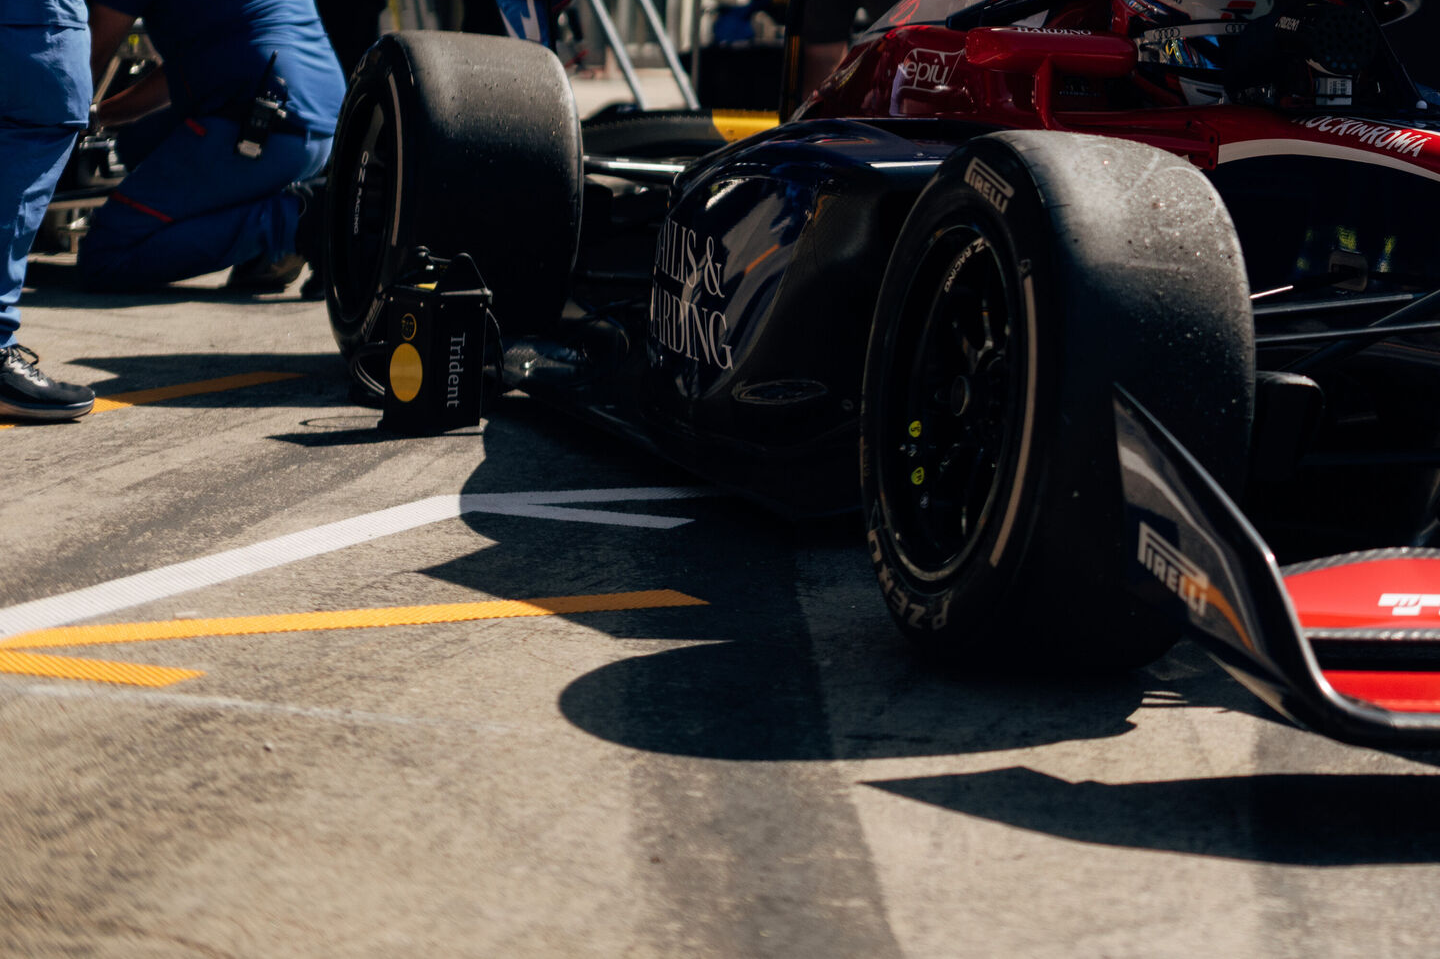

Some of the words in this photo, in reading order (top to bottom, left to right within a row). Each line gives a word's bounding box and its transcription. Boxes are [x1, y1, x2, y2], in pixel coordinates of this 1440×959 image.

[1291, 115, 1432, 158] OCKINROMA
[963, 156, 1015, 214] PIRELLI
[703, 235, 726, 298] &
[446, 331, 466, 409] Trident
[1136, 520, 1211, 617] PIRELLI
